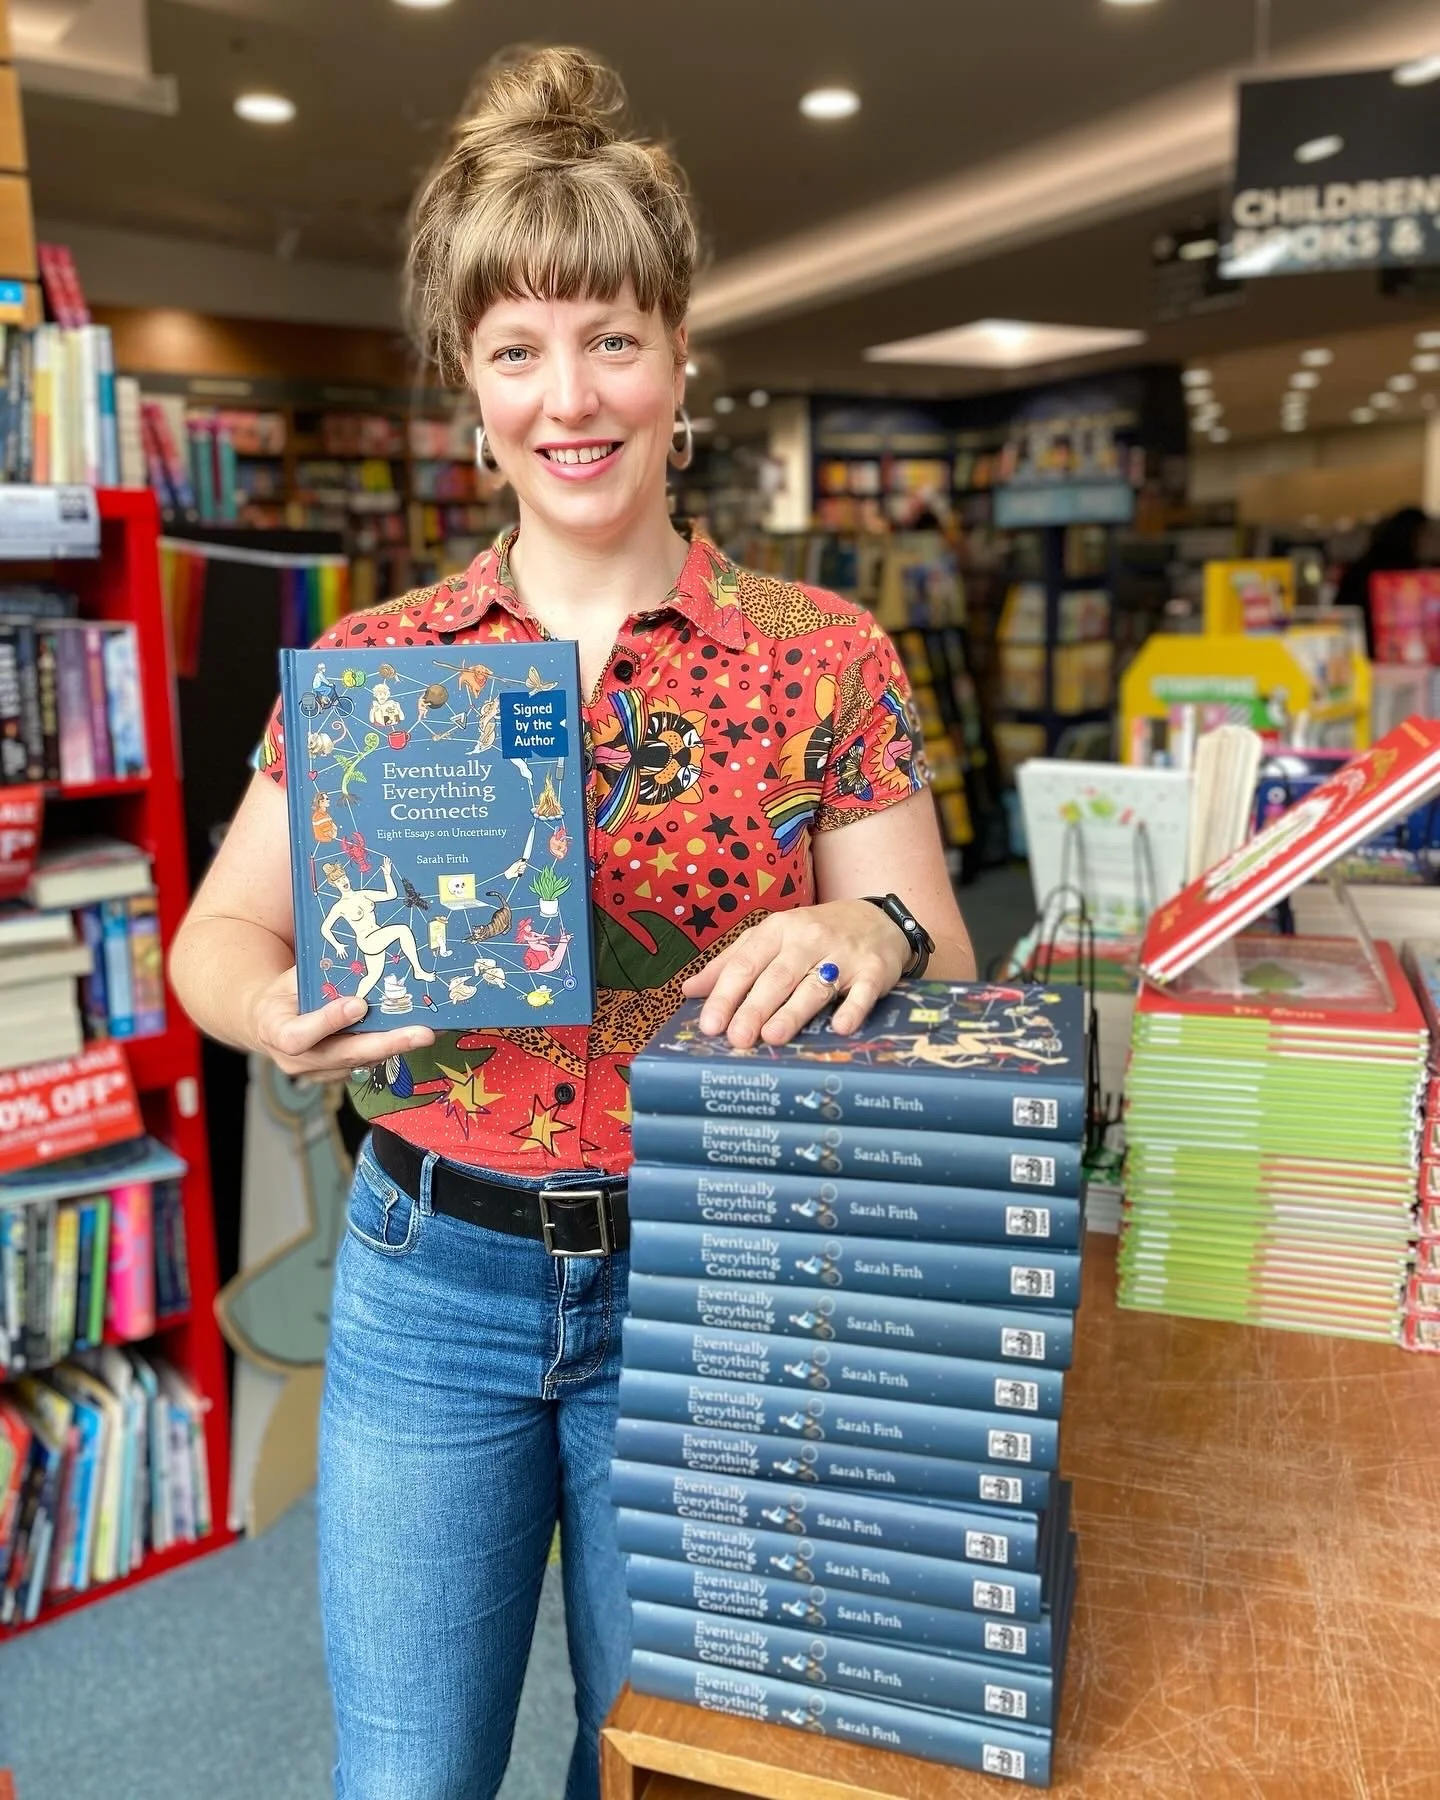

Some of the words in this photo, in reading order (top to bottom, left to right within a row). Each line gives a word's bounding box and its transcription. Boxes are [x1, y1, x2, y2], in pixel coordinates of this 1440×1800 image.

[513, 703, 553, 719] Signed
[515, 719, 531, 733] by
[533, 718, 552, 731] the
[514, 734, 555, 747] Author
[384, 760, 493, 781] Eventually
[384, 782, 496, 803] Everything
[390, 803, 489, 821] Connects
[377, 828, 402, 841] Eight
[404, 827, 436, 841] Essays
[437, 830, 450, 839] on
[451, 826, 507, 840] Uncertainty
[416, 853, 443, 865] Sarah
[445, 852, 469, 864] Firth
[701, 1071, 780, 1091] Eventually
[700, 1086, 781, 1106] Everything
[854, 1094, 889, 1110] Sarah
[893, 1097, 924, 1113] Firth
[705, 1101, 776, 1116] Connects
[703, 1120, 780, 1141] Eventually
[702, 1136, 781, 1157] Everything
[707, 1150, 776, 1166] Connects
[854, 1148, 888, 1163] Sarah
[892, 1151, 922, 1168] Firth
[698, 1178, 775, 1198] Eventually
[697, 1193, 776, 1214] Everything
[850, 1202, 884, 1216] Sarah
[888, 1205, 918, 1221] Firth
[702, 1208, 772, 1224] Connects
[702, 1234, 780, 1254] Eventually
[701, 1248, 780, 1270] Everything
[854, 1260, 889, 1276] Sarah
[892, 1263, 923, 1279] Firth
[706, 1264, 776, 1280] Connects
[698, 1286, 774, 1307] Eventually
[697, 1301, 775, 1323] Everything
[702, 1316, 771, 1332] Connects
[847, 1317, 881, 1333] Sarah
[885, 1321, 914, 1338] Firth
[692, 1335, 769, 1356] Eventually
[692, 1350, 770, 1373] Everything
[697, 1365, 765, 1382] Connects
[841, 1368, 876, 1384] Sarah
[879, 1371, 908, 1388] Firth
[688, 1386, 764, 1408] Eventually
[688, 1401, 765, 1424] Everything
[693, 1415, 760, 1432] Connects
[836, 1418, 871, 1434] Sarah
[874, 1423, 903, 1439] Firth
[682, 1434, 758, 1455] Eventually
[682, 1448, 760, 1470] Everything
[830, 1464, 864, 1480] Sarah
[867, 1468, 896, 1484] Firth
[674, 1477, 746, 1502] Eventually
[673, 1494, 748, 1517] Everything
[678, 1508, 744, 1524] Connects
[818, 1515, 852, 1532] Sarah
[854, 1520, 882, 1536] Firth
[683, 1524, 756, 1550] Eventually
[682, 1538, 756, 1566] Everything
[687, 1552, 752, 1572] Connects
[694, 1571, 766, 1594] Eventually
[825, 1563, 859, 1579] Sarah
[862, 1568, 890, 1585] Firth
[693, 1586, 768, 1609] Everything
[698, 1599, 764, 1618] Connects
[837, 1607, 872, 1624] Sarah
[874, 1612, 902, 1629] Firth
[696, 1621, 768, 1647] Eventually
[694, 1635, 769, 1662] Everything
[699, 1649, 764, 1670] Connects
[696, 1672, 767, 1699] Eventually
[838, 1663, 872, 1680] Sarah
[874, 1670, 902, 1687] Firth
[695, 1687, 768, 1714] Everything
[837, 1718, 871, 1736] Sarah
[873, 1726, 901, 1744] Firth
